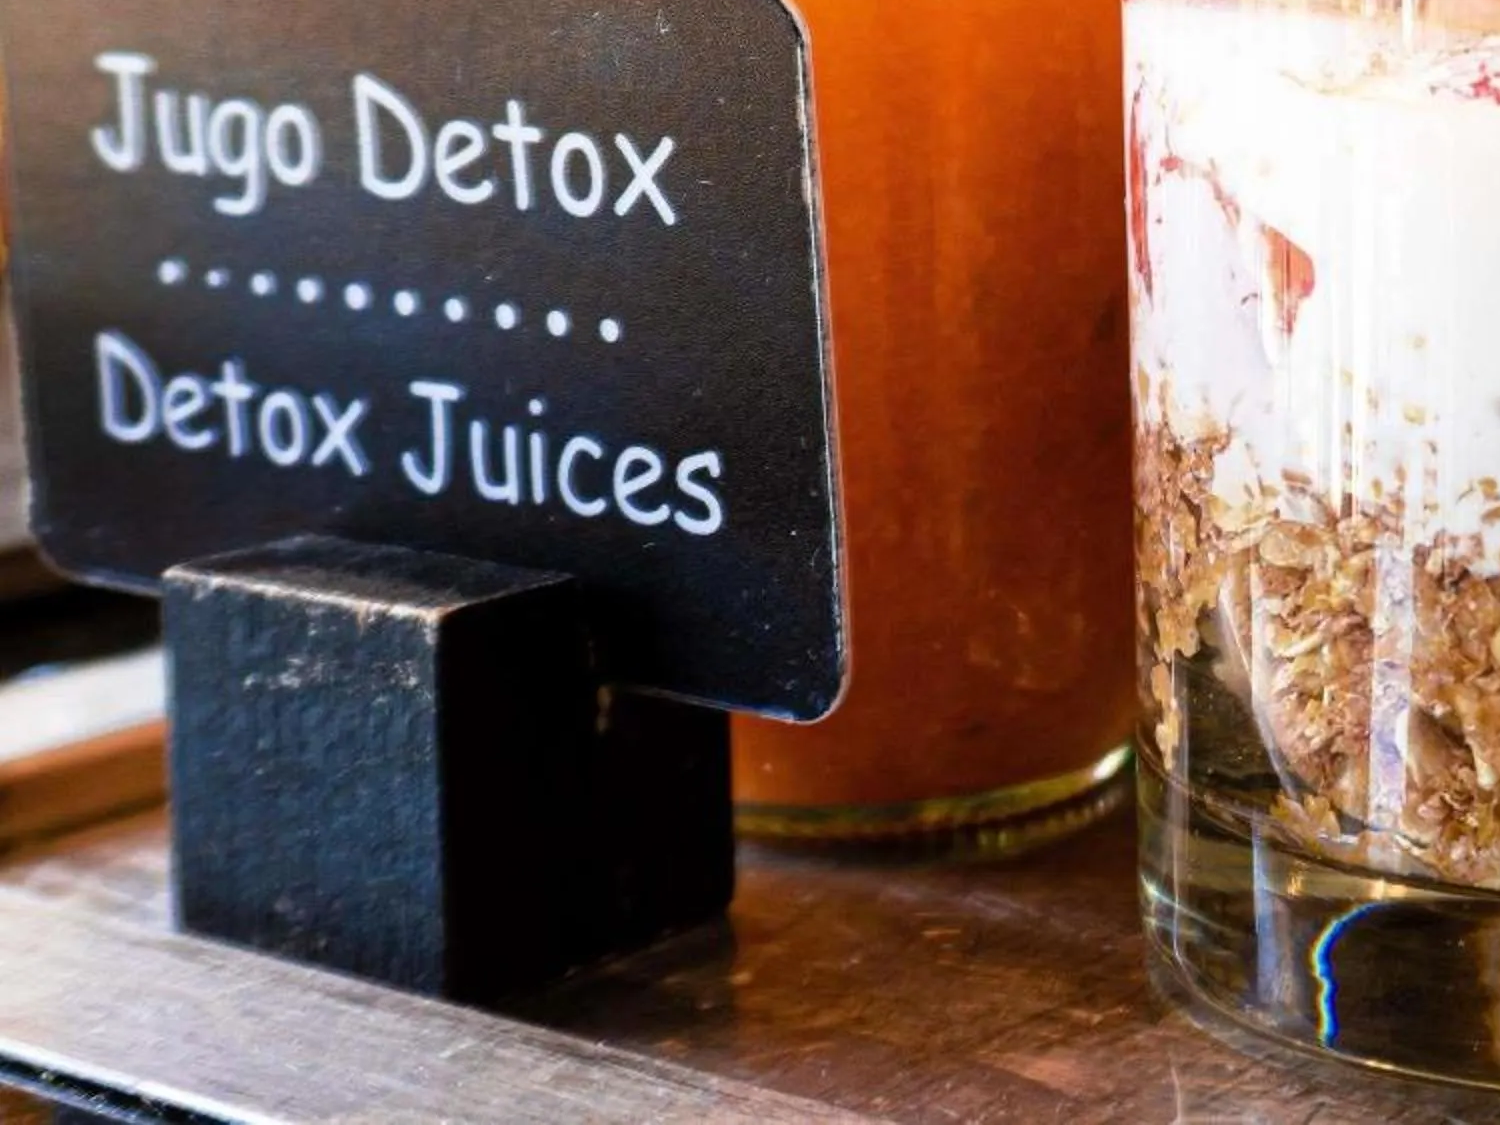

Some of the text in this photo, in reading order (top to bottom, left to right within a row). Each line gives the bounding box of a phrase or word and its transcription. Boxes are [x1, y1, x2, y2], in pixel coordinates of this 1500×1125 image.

[90, 49, 677, 226] Jugo Detox
[95, 332, 726, 537] Detox Juices
